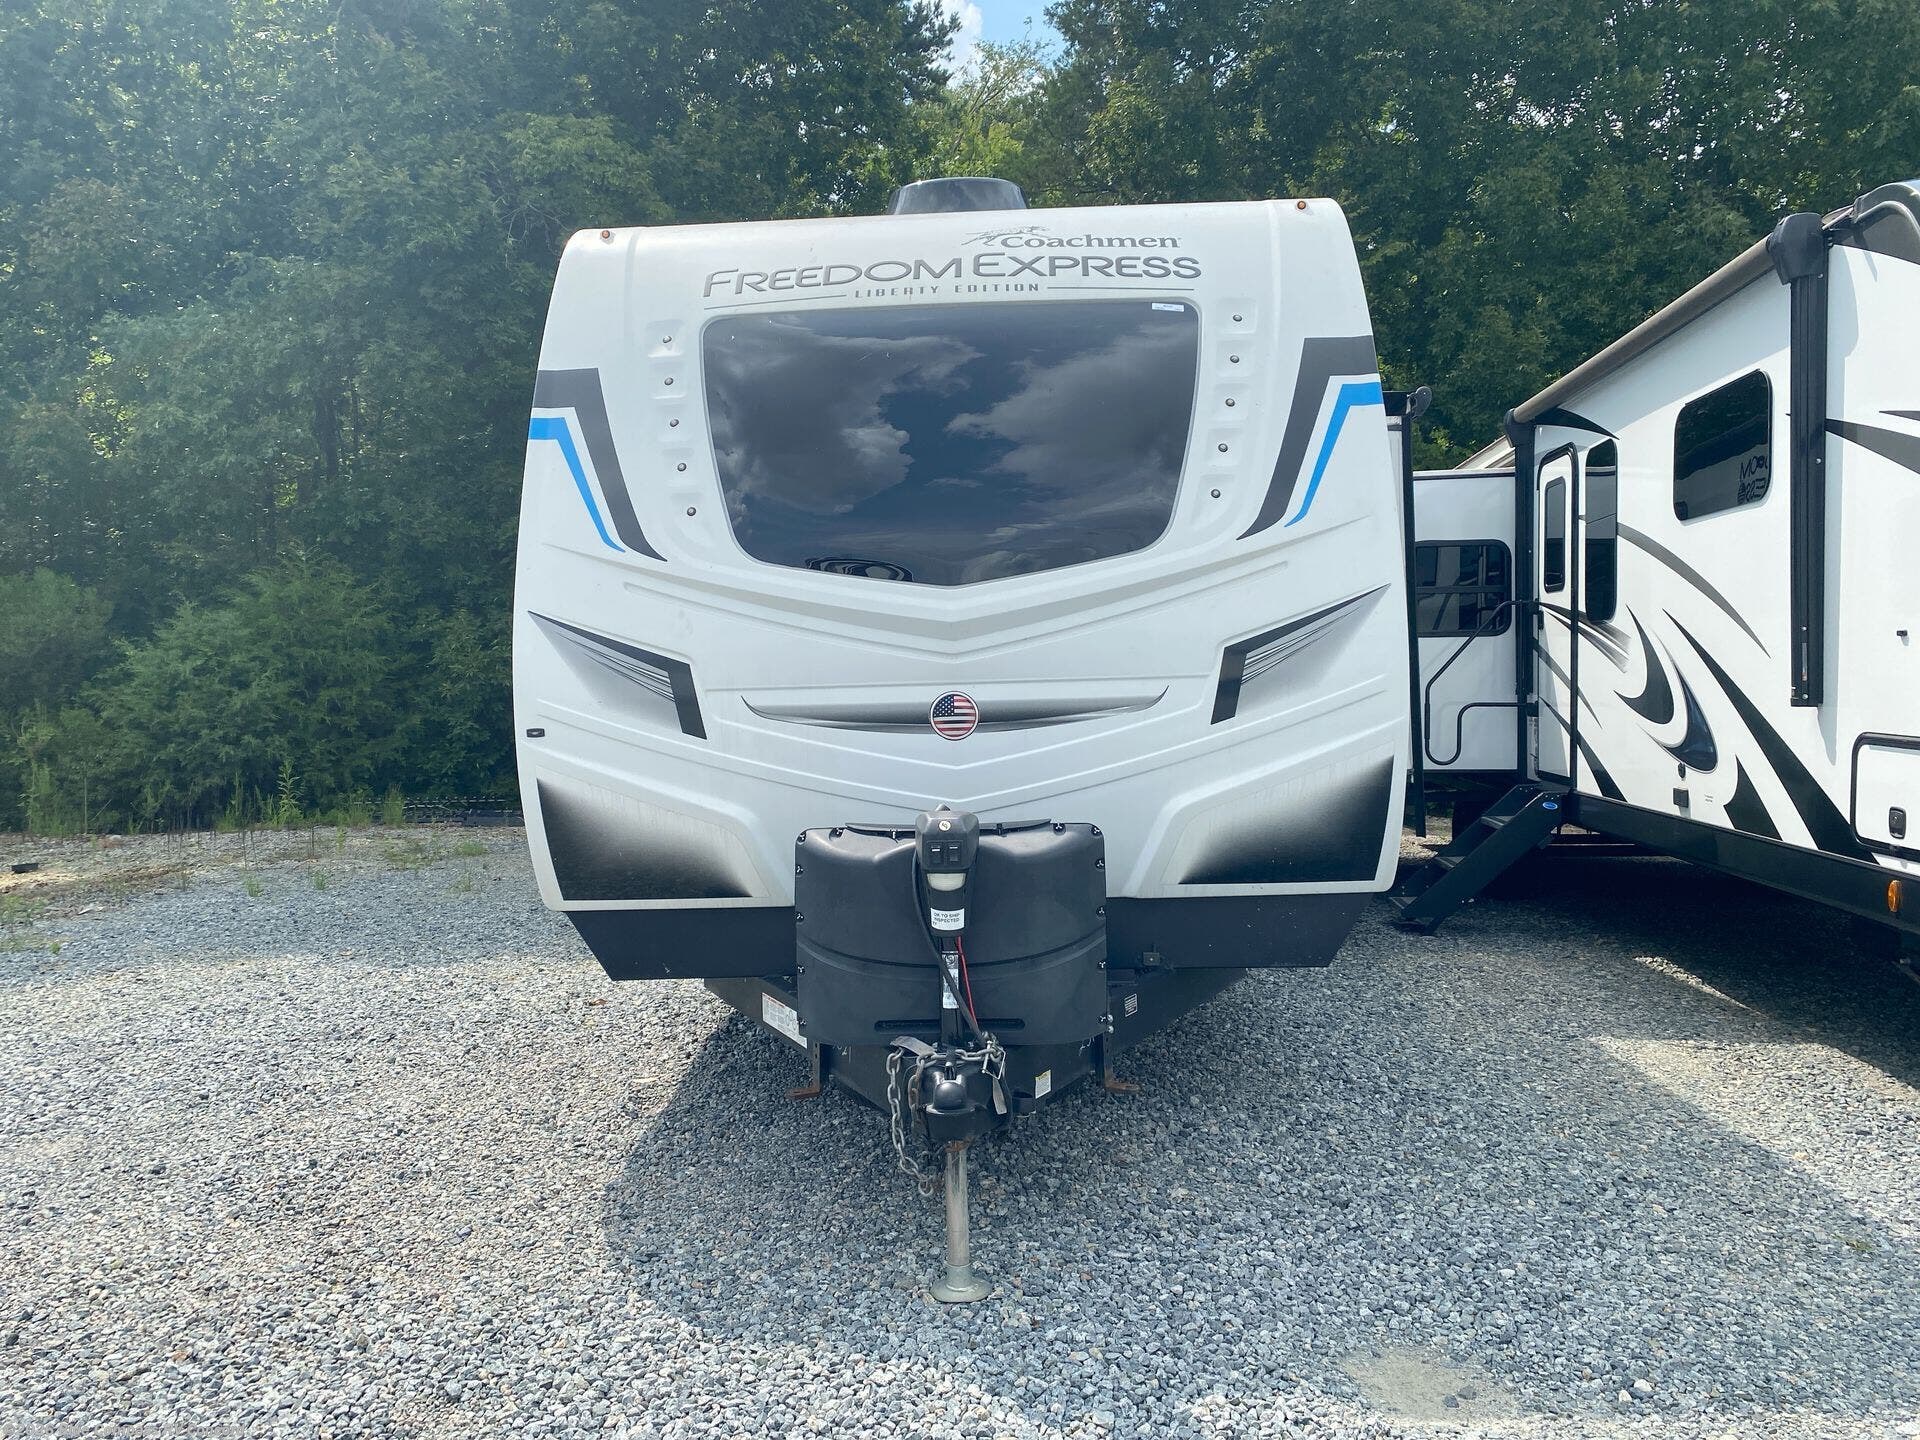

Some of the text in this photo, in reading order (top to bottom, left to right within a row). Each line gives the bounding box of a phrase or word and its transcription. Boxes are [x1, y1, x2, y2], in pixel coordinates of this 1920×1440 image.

[1000, 234, 1180, 248] Coachmen
[703, 252, 1202, 298] FREEDOM EXPRESS
[855, 283, 1039, 298] LIBERTY EDITION
